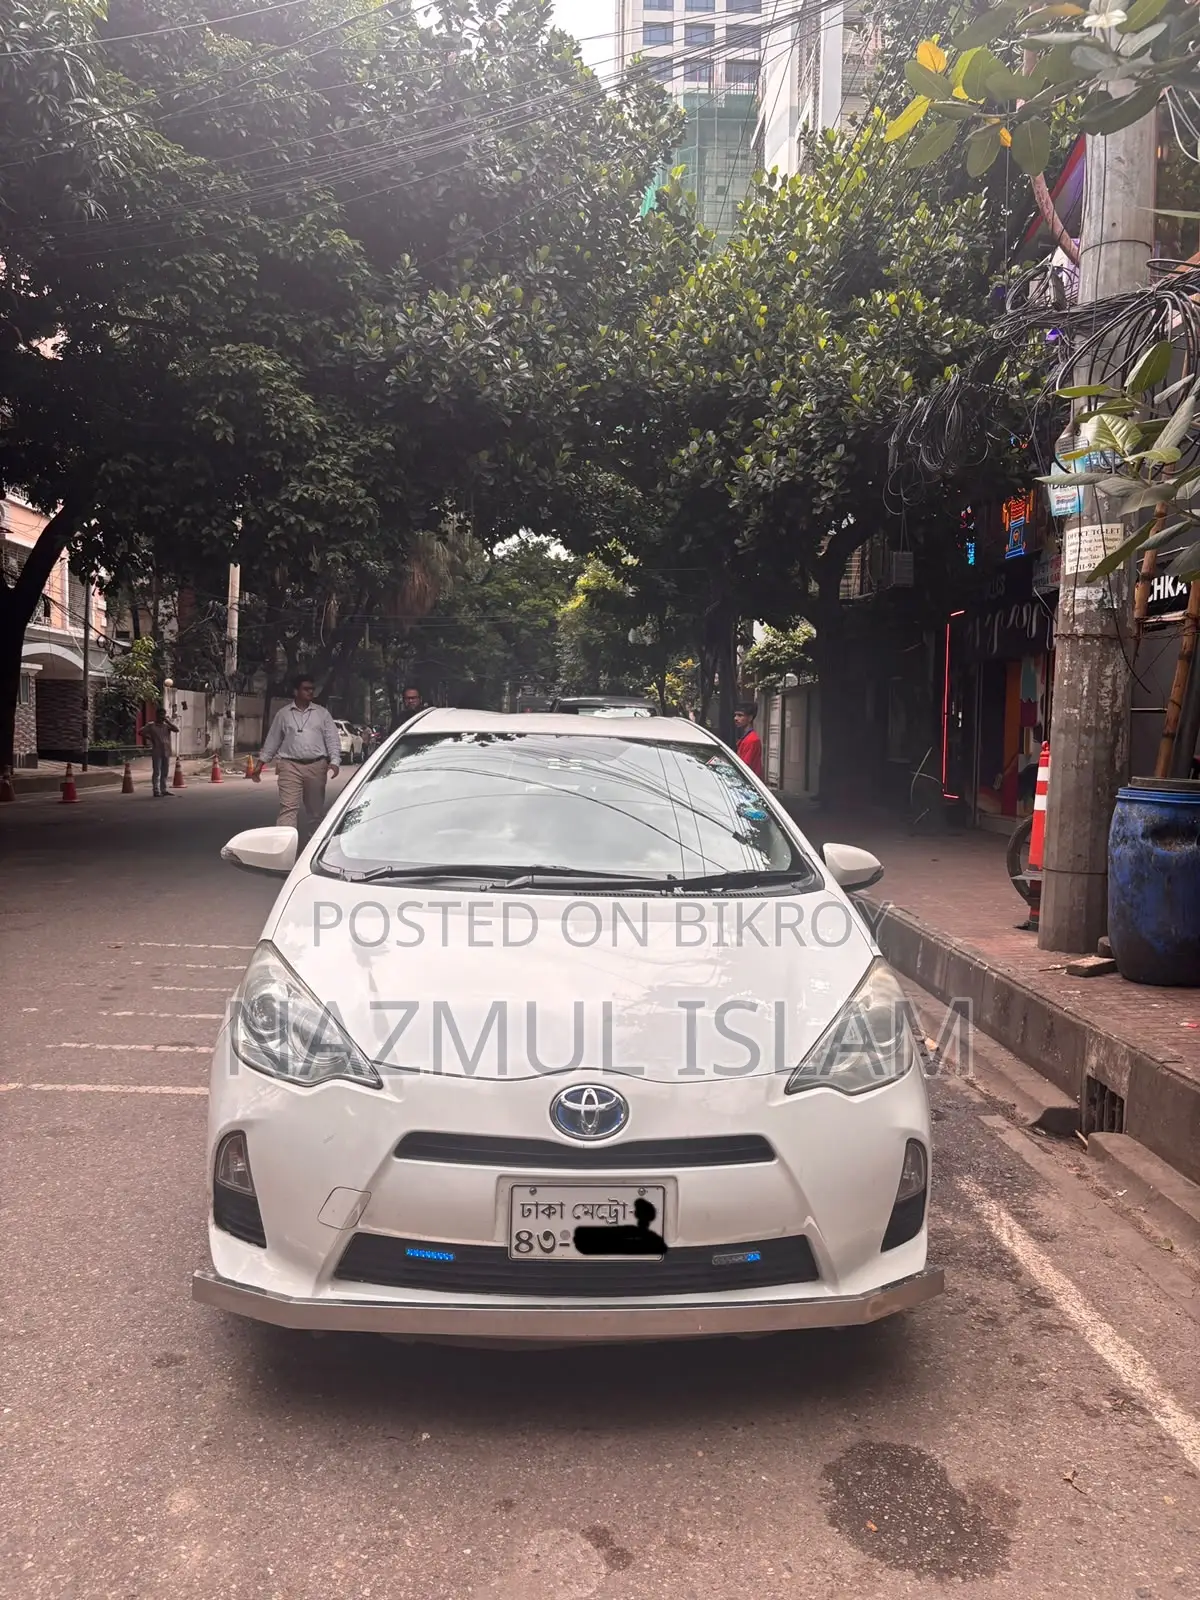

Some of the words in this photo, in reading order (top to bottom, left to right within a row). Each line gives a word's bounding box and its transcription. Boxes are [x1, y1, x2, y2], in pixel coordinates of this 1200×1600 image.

[1068, 529, 1088, 540] OFFCE
[520, 1201, 565, 1220] ঢাকা
[572, 1198, 636, 1224] মেট্রো-
[514, 1229, 571, 1253] ৪৩-
